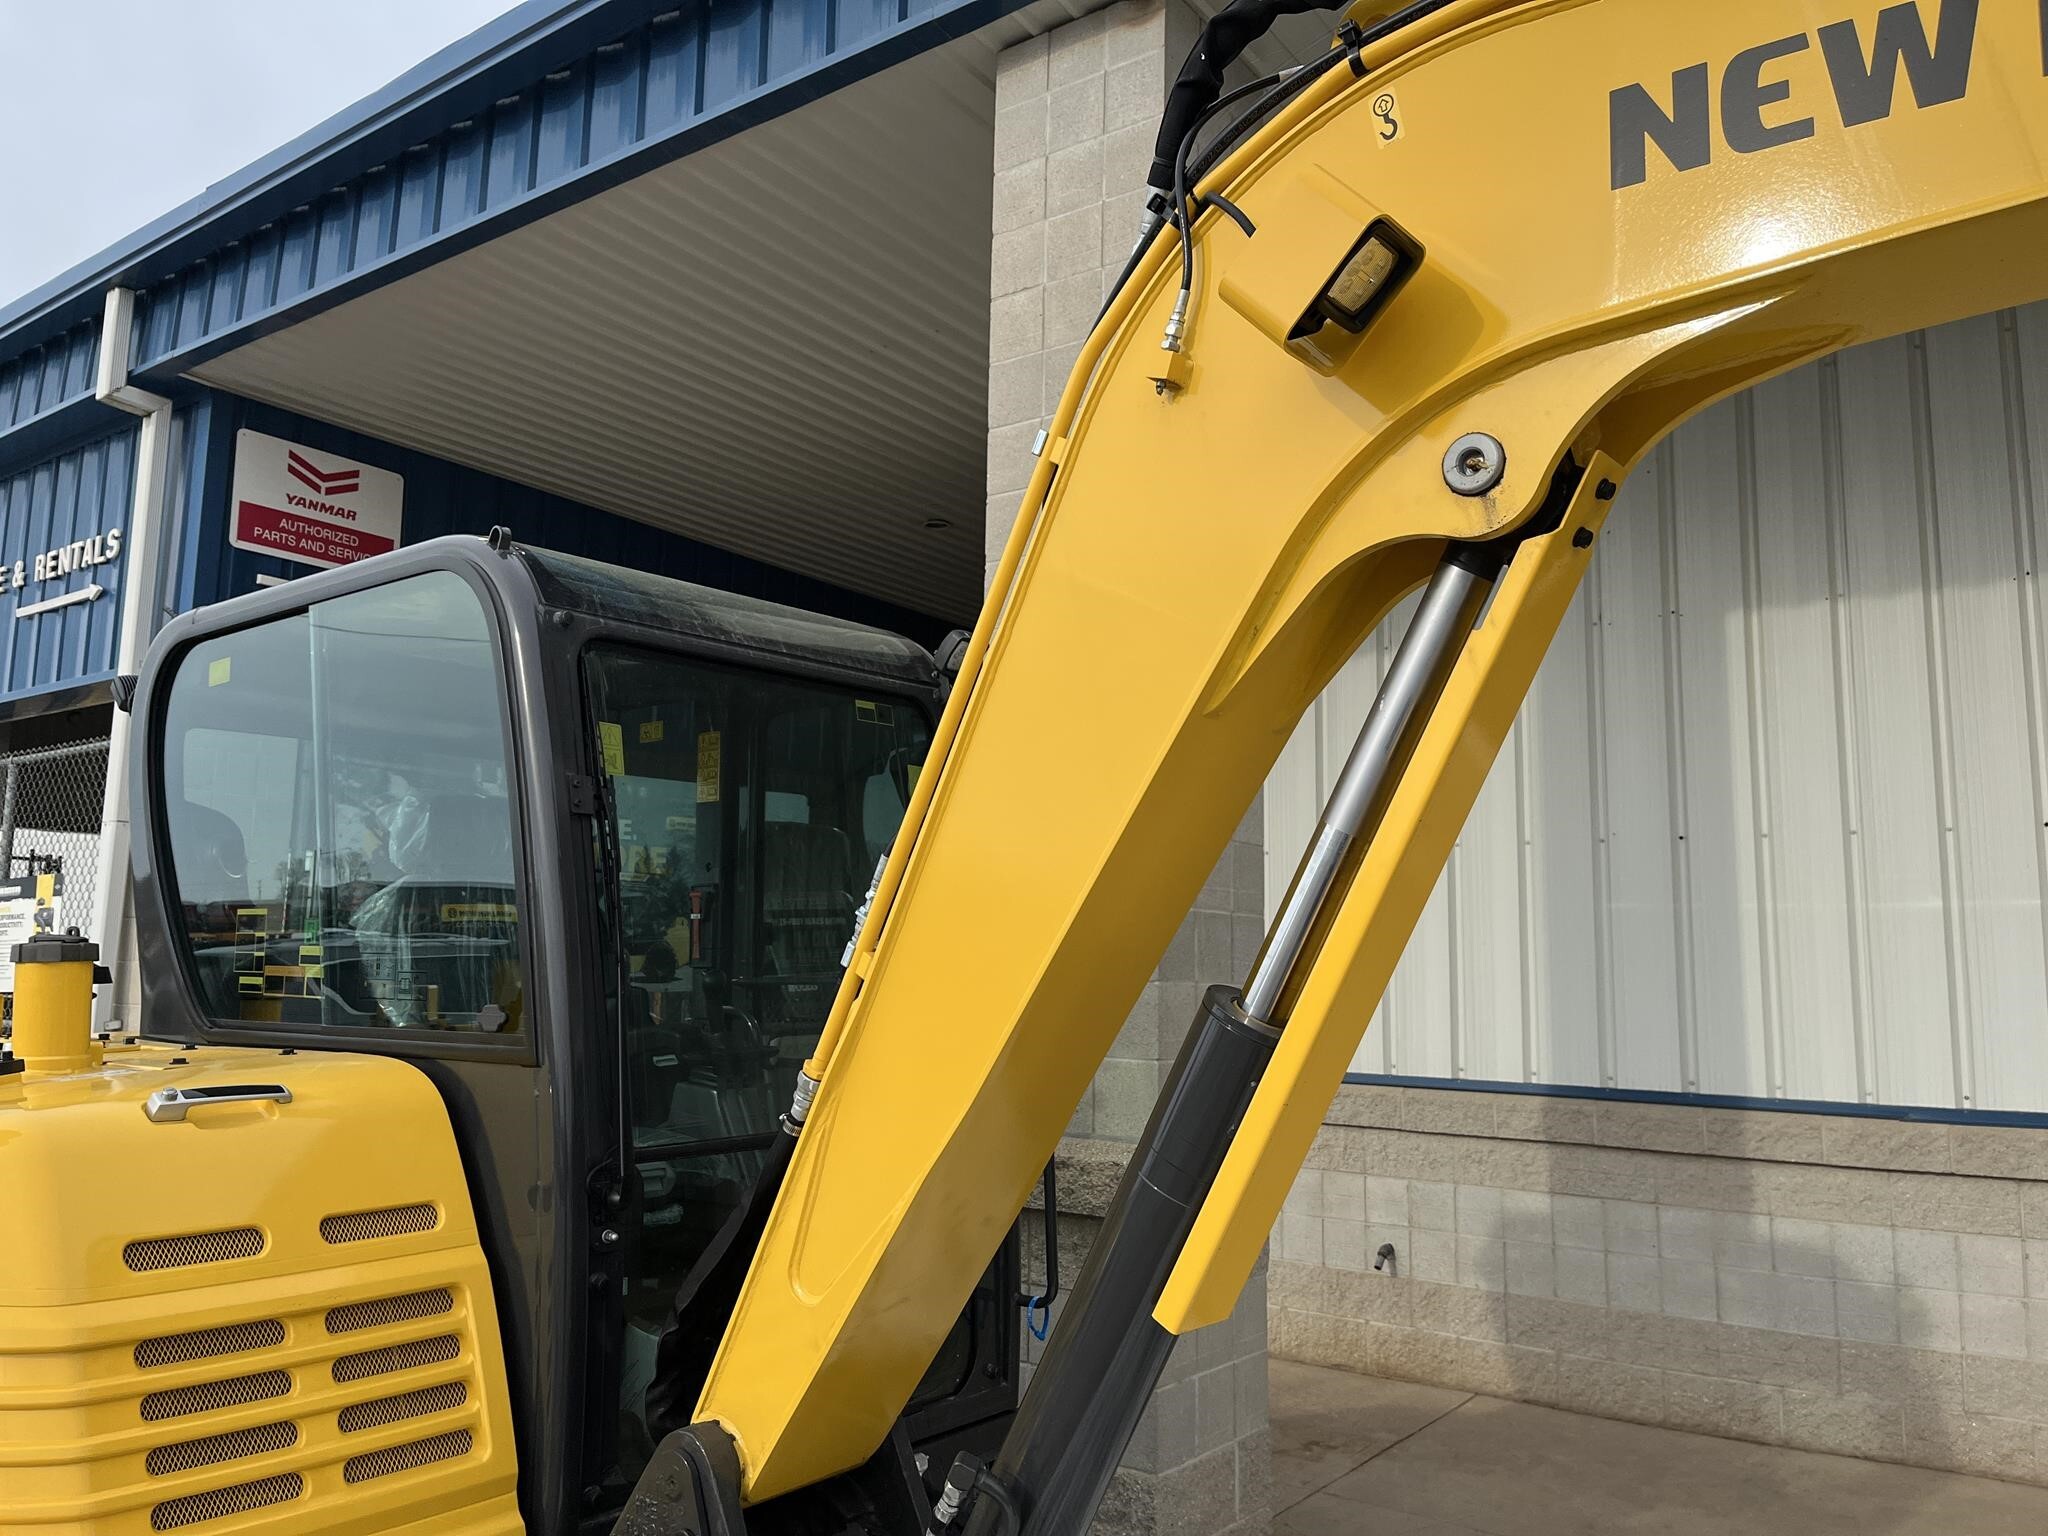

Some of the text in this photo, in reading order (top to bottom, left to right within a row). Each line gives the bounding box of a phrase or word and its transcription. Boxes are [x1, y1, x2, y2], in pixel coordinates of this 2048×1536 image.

[1609, 0, 1979, 191] NEW
[286, 493, 357, 521] YANMAR
[253, 527, 296, 547] PARTS
[299, 538, 325, 553] AND
[279, 518, 359, 547] AUTHORIZED
[12, 560, 25, 588] &
[34, 528, 122, 582] RENTALS
